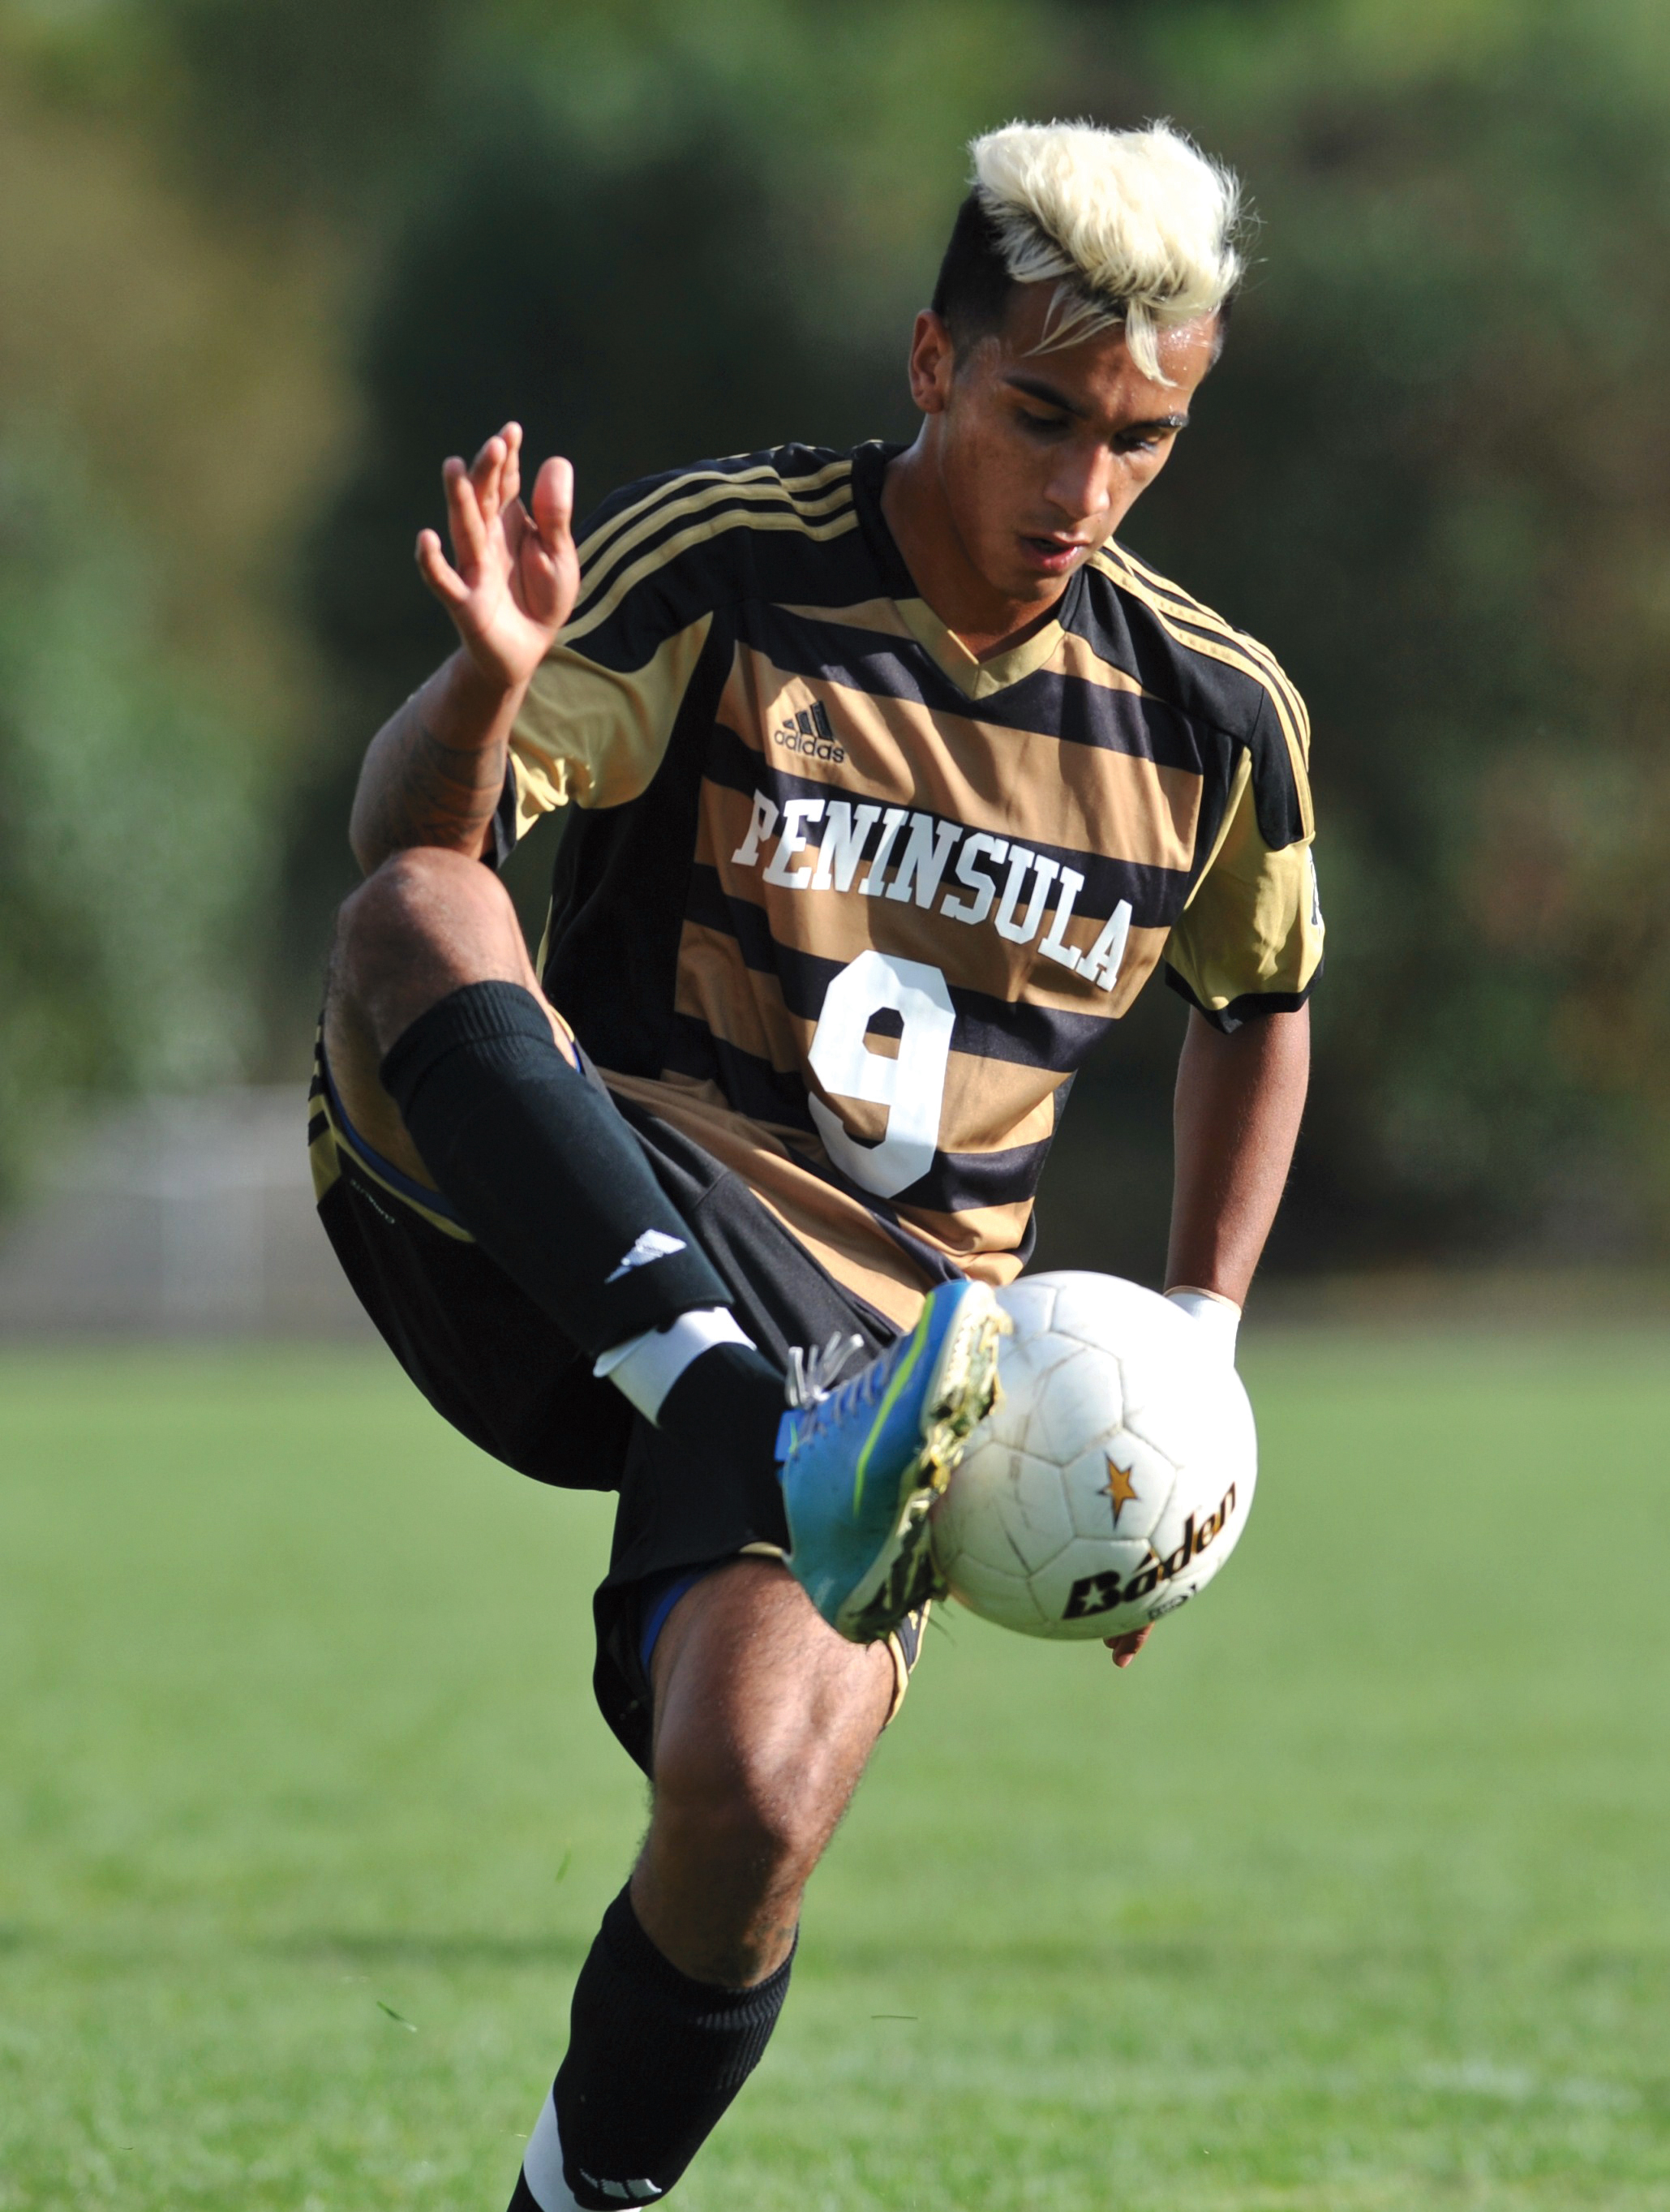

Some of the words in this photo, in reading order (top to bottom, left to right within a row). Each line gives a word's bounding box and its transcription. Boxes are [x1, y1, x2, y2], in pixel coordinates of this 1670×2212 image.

[775, 730, 844, 763] adidas
[732, 788, 1133, 992] PENINSULA
[808, 949, 956, 1199] 9
